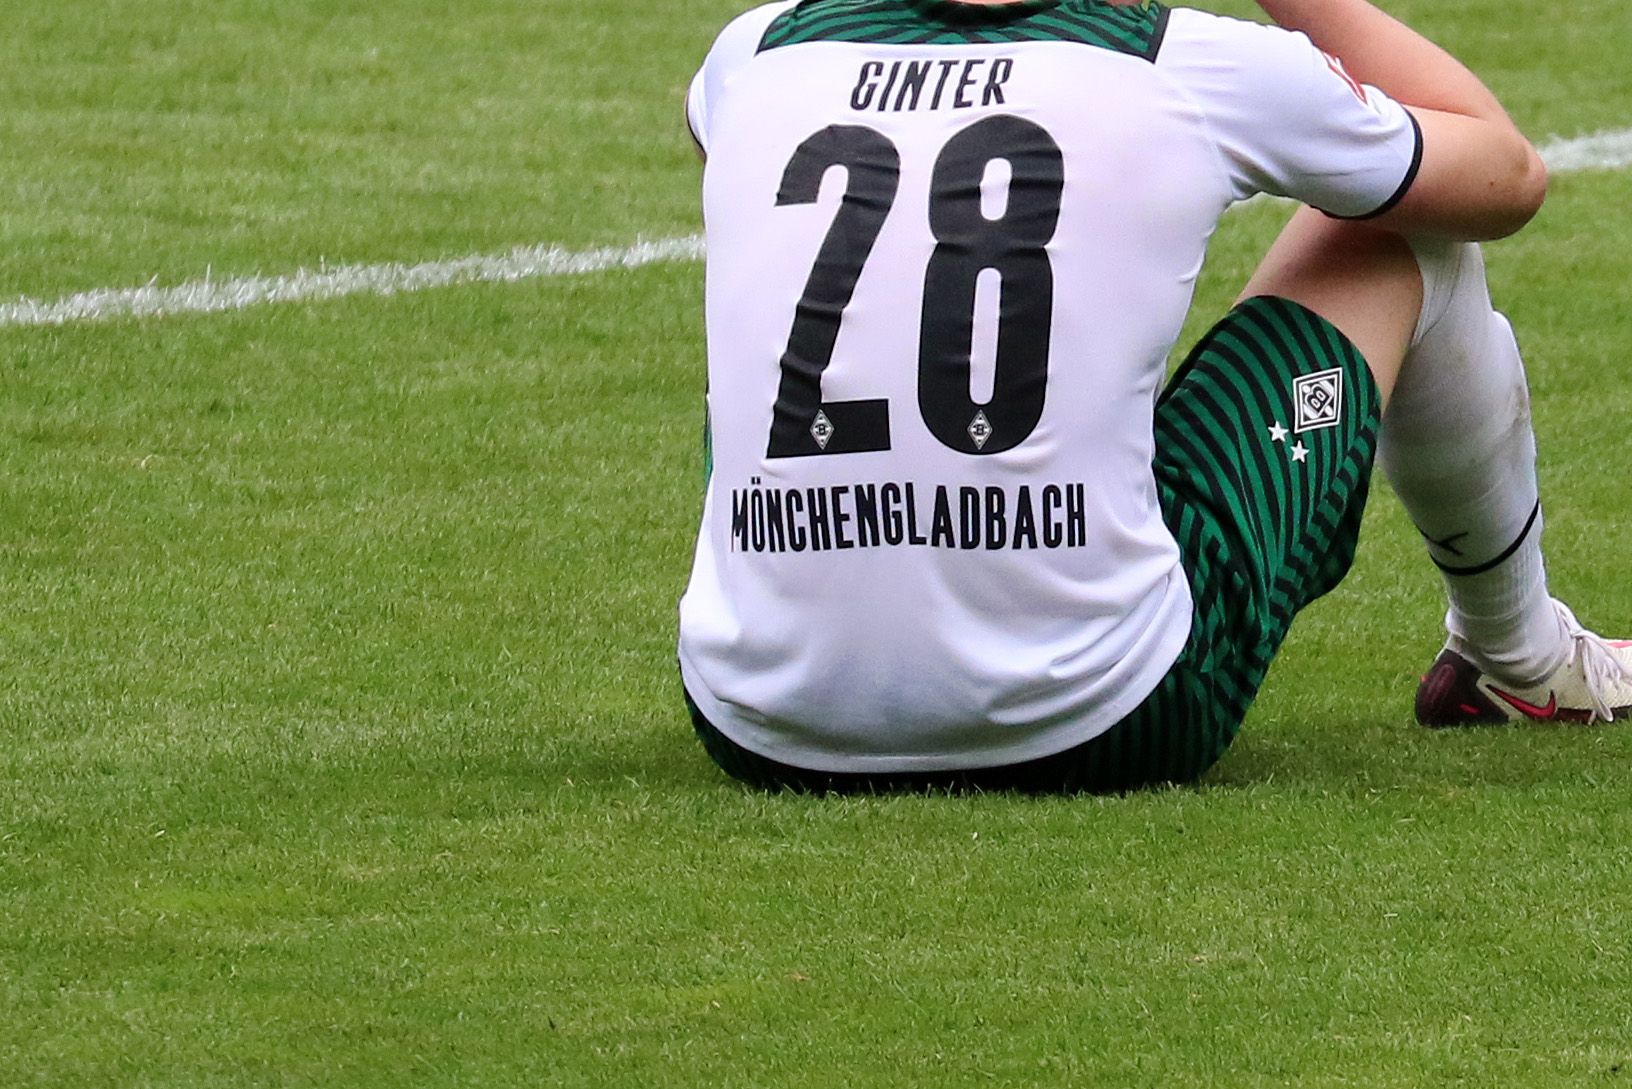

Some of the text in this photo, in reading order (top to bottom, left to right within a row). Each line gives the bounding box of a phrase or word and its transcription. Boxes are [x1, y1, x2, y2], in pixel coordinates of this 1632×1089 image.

[850, 58, 1013, 111] GINTER
[766, 113, 1065, 460] 28
[731, 476, 1087, 553] MÖNCHENGLADBACH
